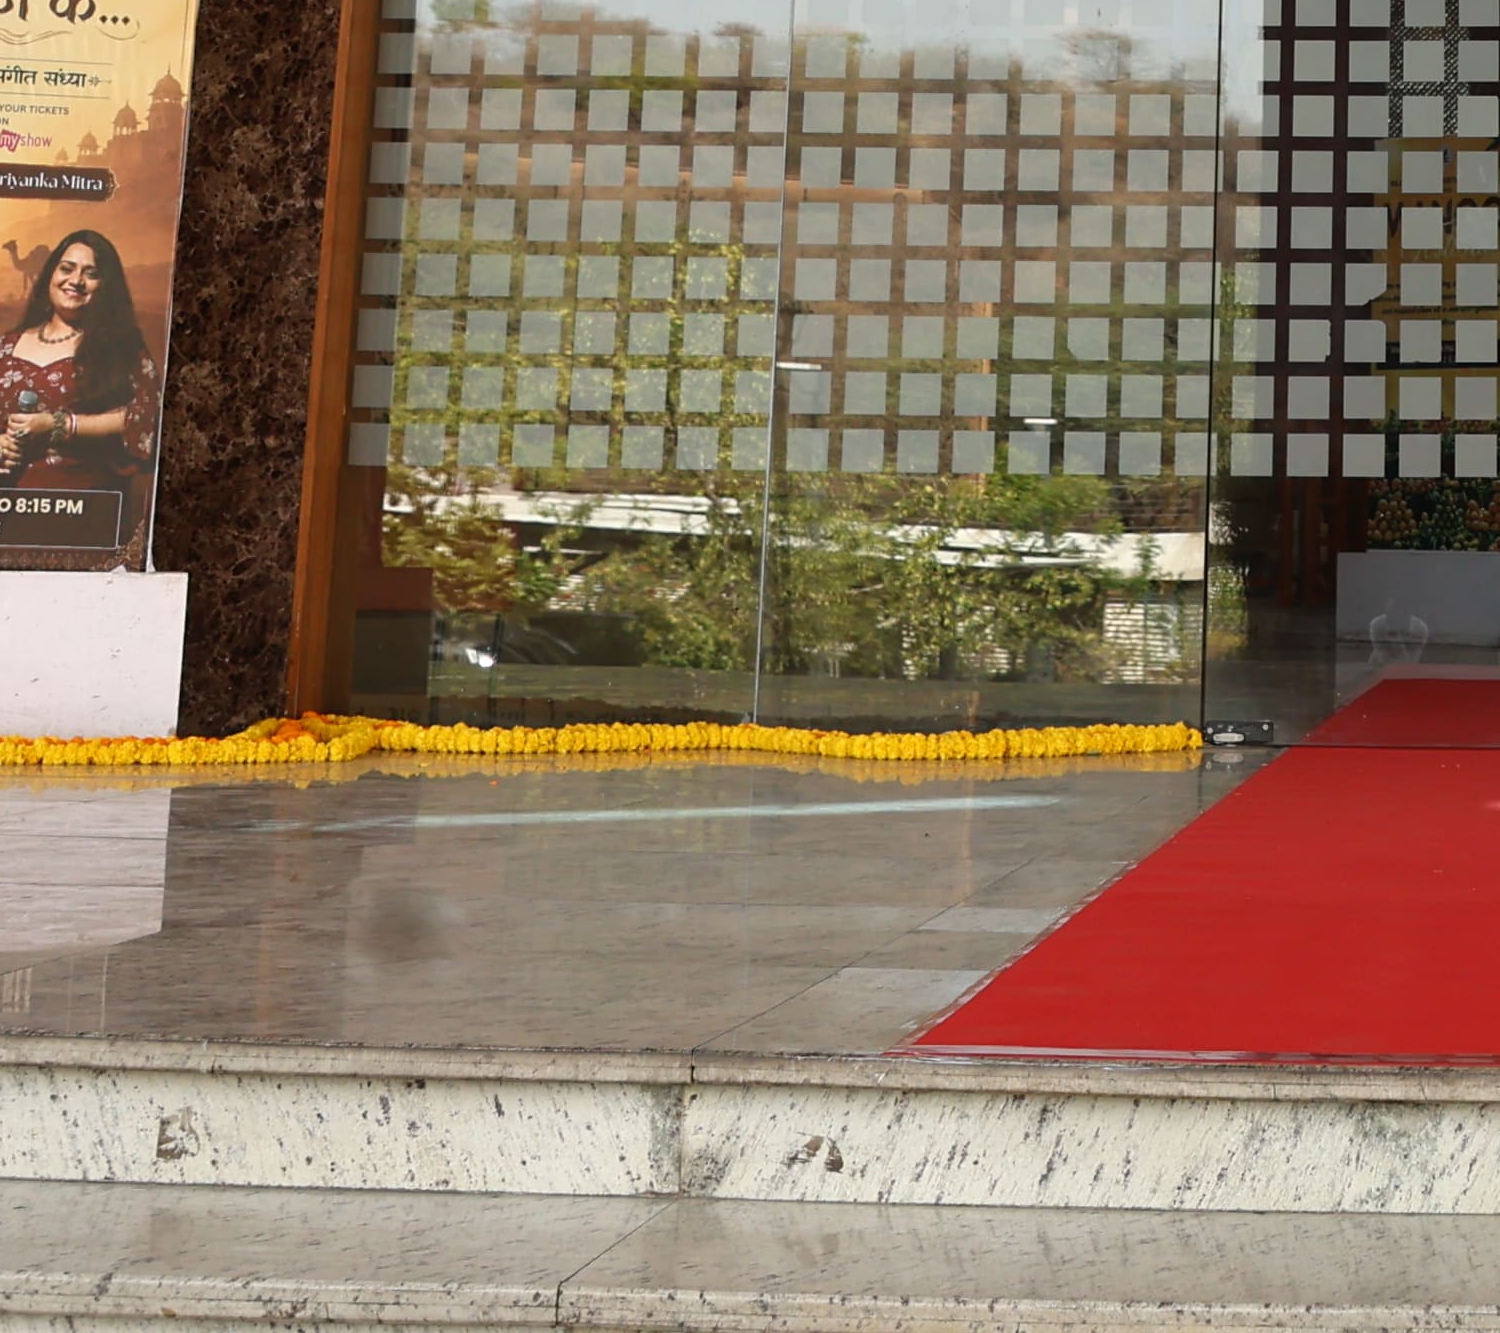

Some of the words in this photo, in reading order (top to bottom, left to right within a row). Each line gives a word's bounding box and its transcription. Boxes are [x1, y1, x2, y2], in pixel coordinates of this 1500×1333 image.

[43, 66, 87, 88] संध्या
[29, 104, 70, 115] TICKETS
[61, 174, 103, 191] Mitra
[15, 497, 51, 514] 8:15
[55, 499, 83, 515] PM
